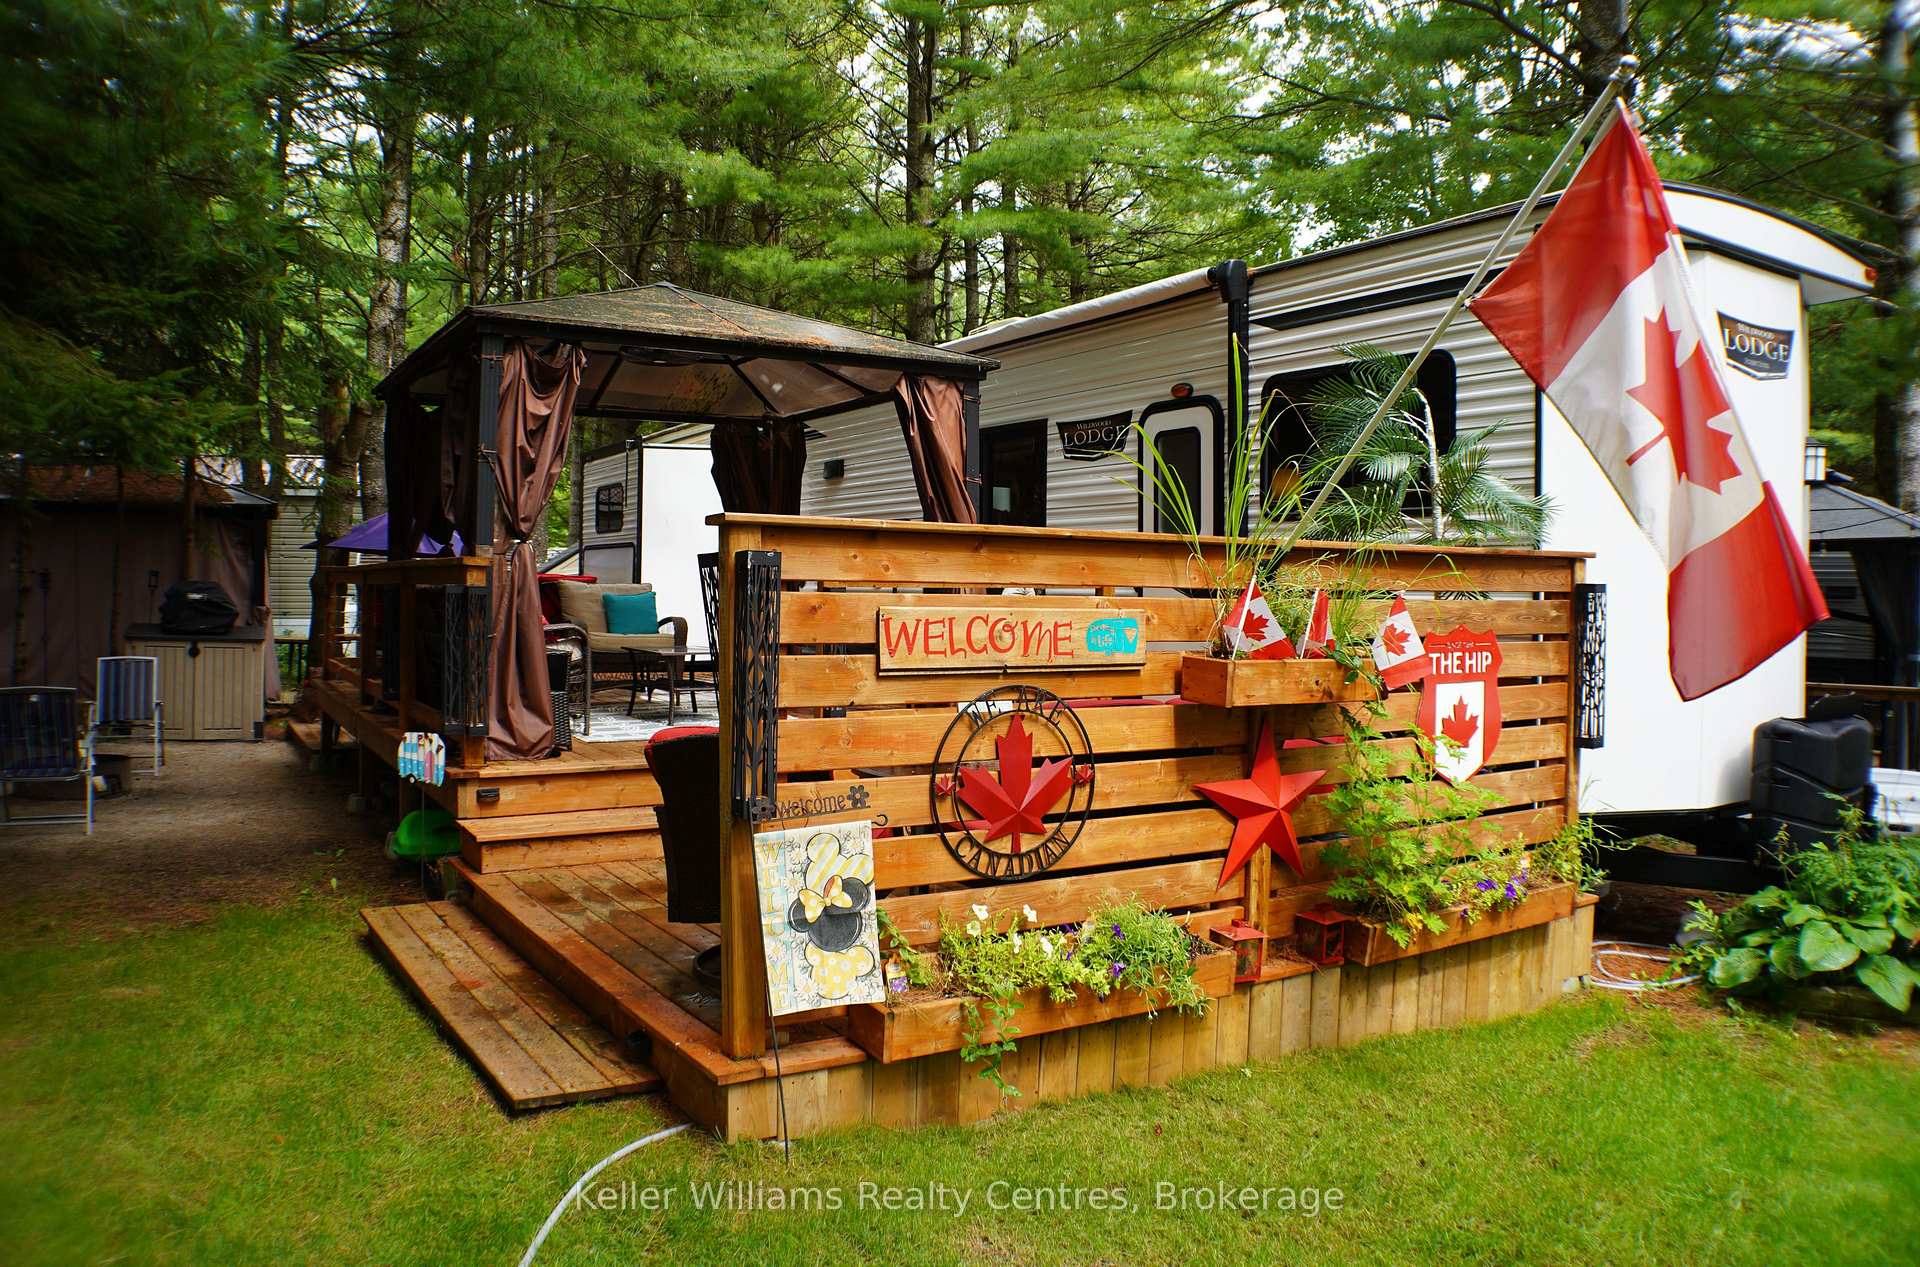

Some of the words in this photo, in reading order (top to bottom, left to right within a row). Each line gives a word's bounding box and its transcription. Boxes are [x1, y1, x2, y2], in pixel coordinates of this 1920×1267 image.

[1723, 328, 1790, 362] LODGE
[1064, 424, 1126, 447] LODGE
[881, 613, 1074, 663] WELCOME
[1428, 651, 1463, 675] THE
[1465, 651, 1492, 674] HIP
[777, 793, 846, 818] welcome
[955, 828, 1071, 878] CANADIAN
